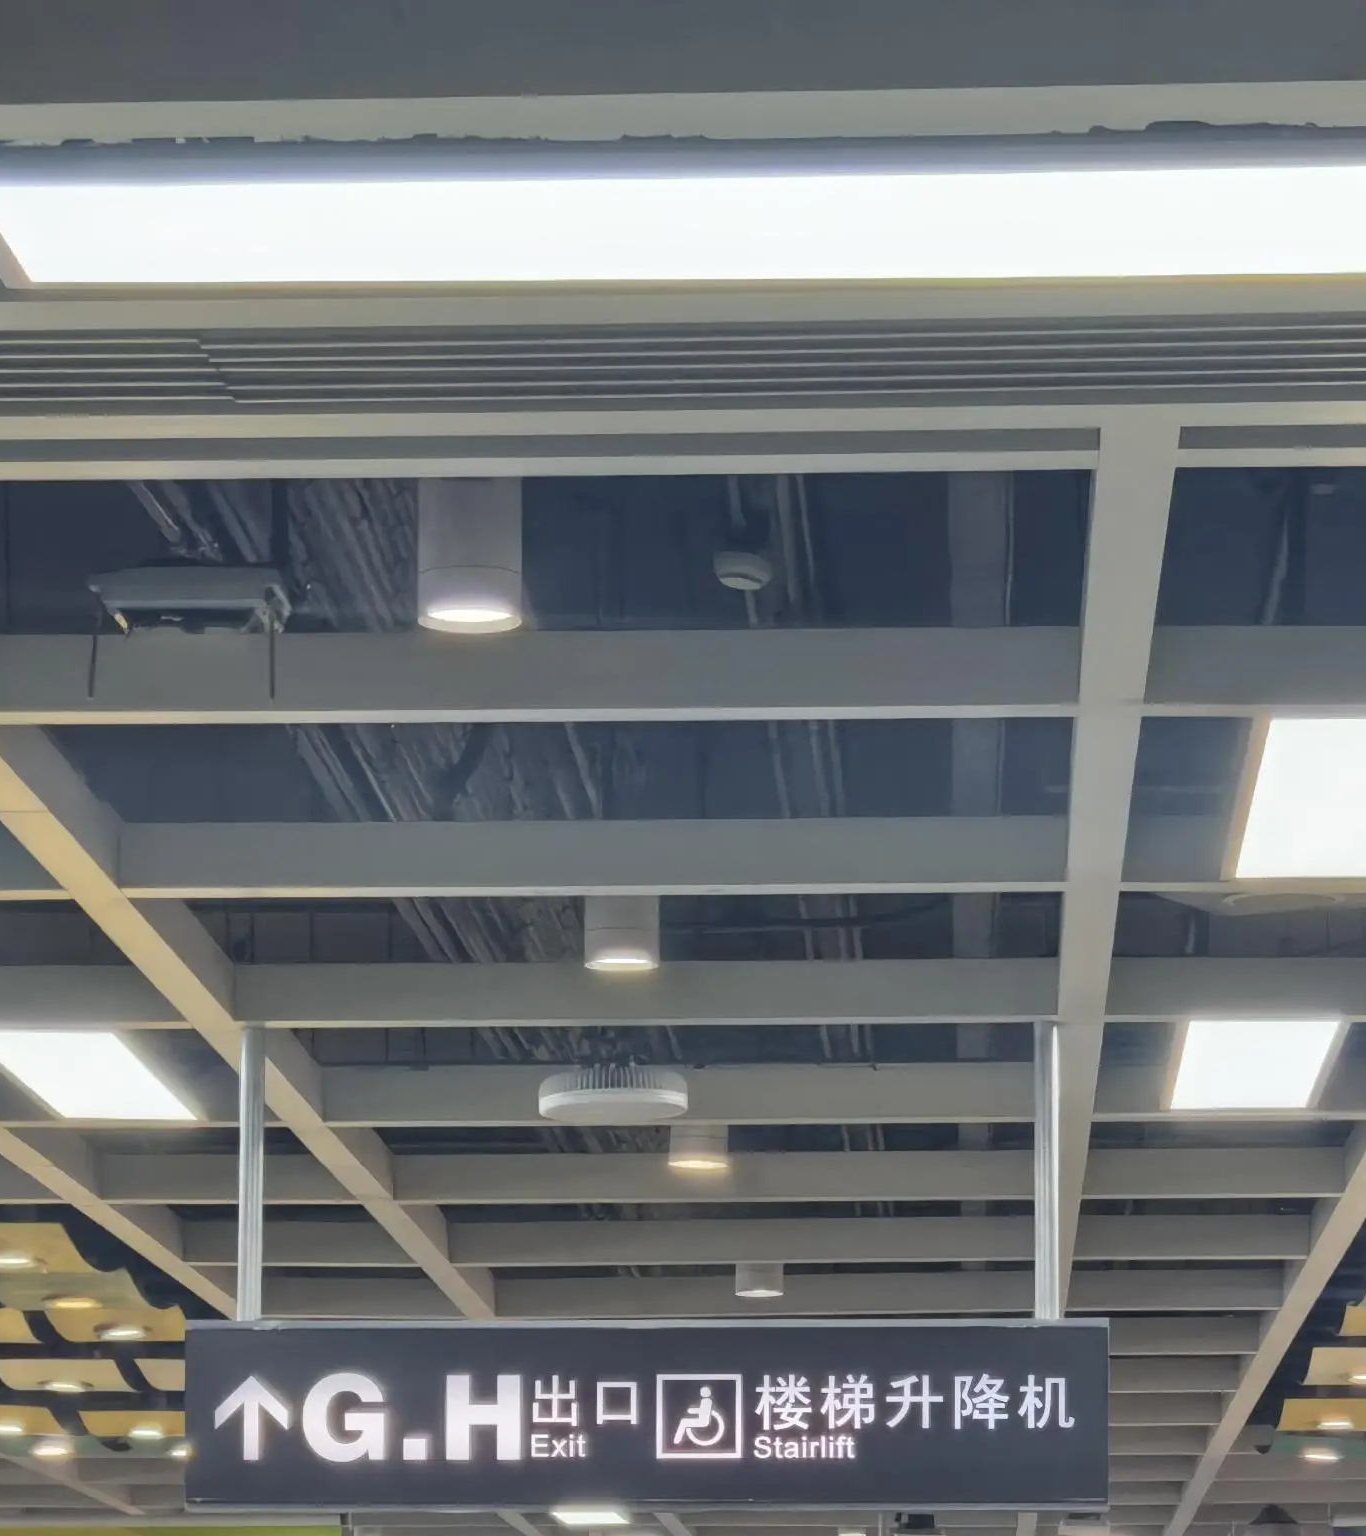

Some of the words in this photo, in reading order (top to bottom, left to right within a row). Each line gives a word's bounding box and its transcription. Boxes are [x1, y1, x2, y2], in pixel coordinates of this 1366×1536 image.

[302, 1373, 522, 1462] G.H
[531, 1378, 639, 1427] 出口
[753, 1373, 1075, 1432] 楼梯升降机
[531, 1434, 587, 1458] Exit
[754, 1434, 857, 1460] Stairlift
